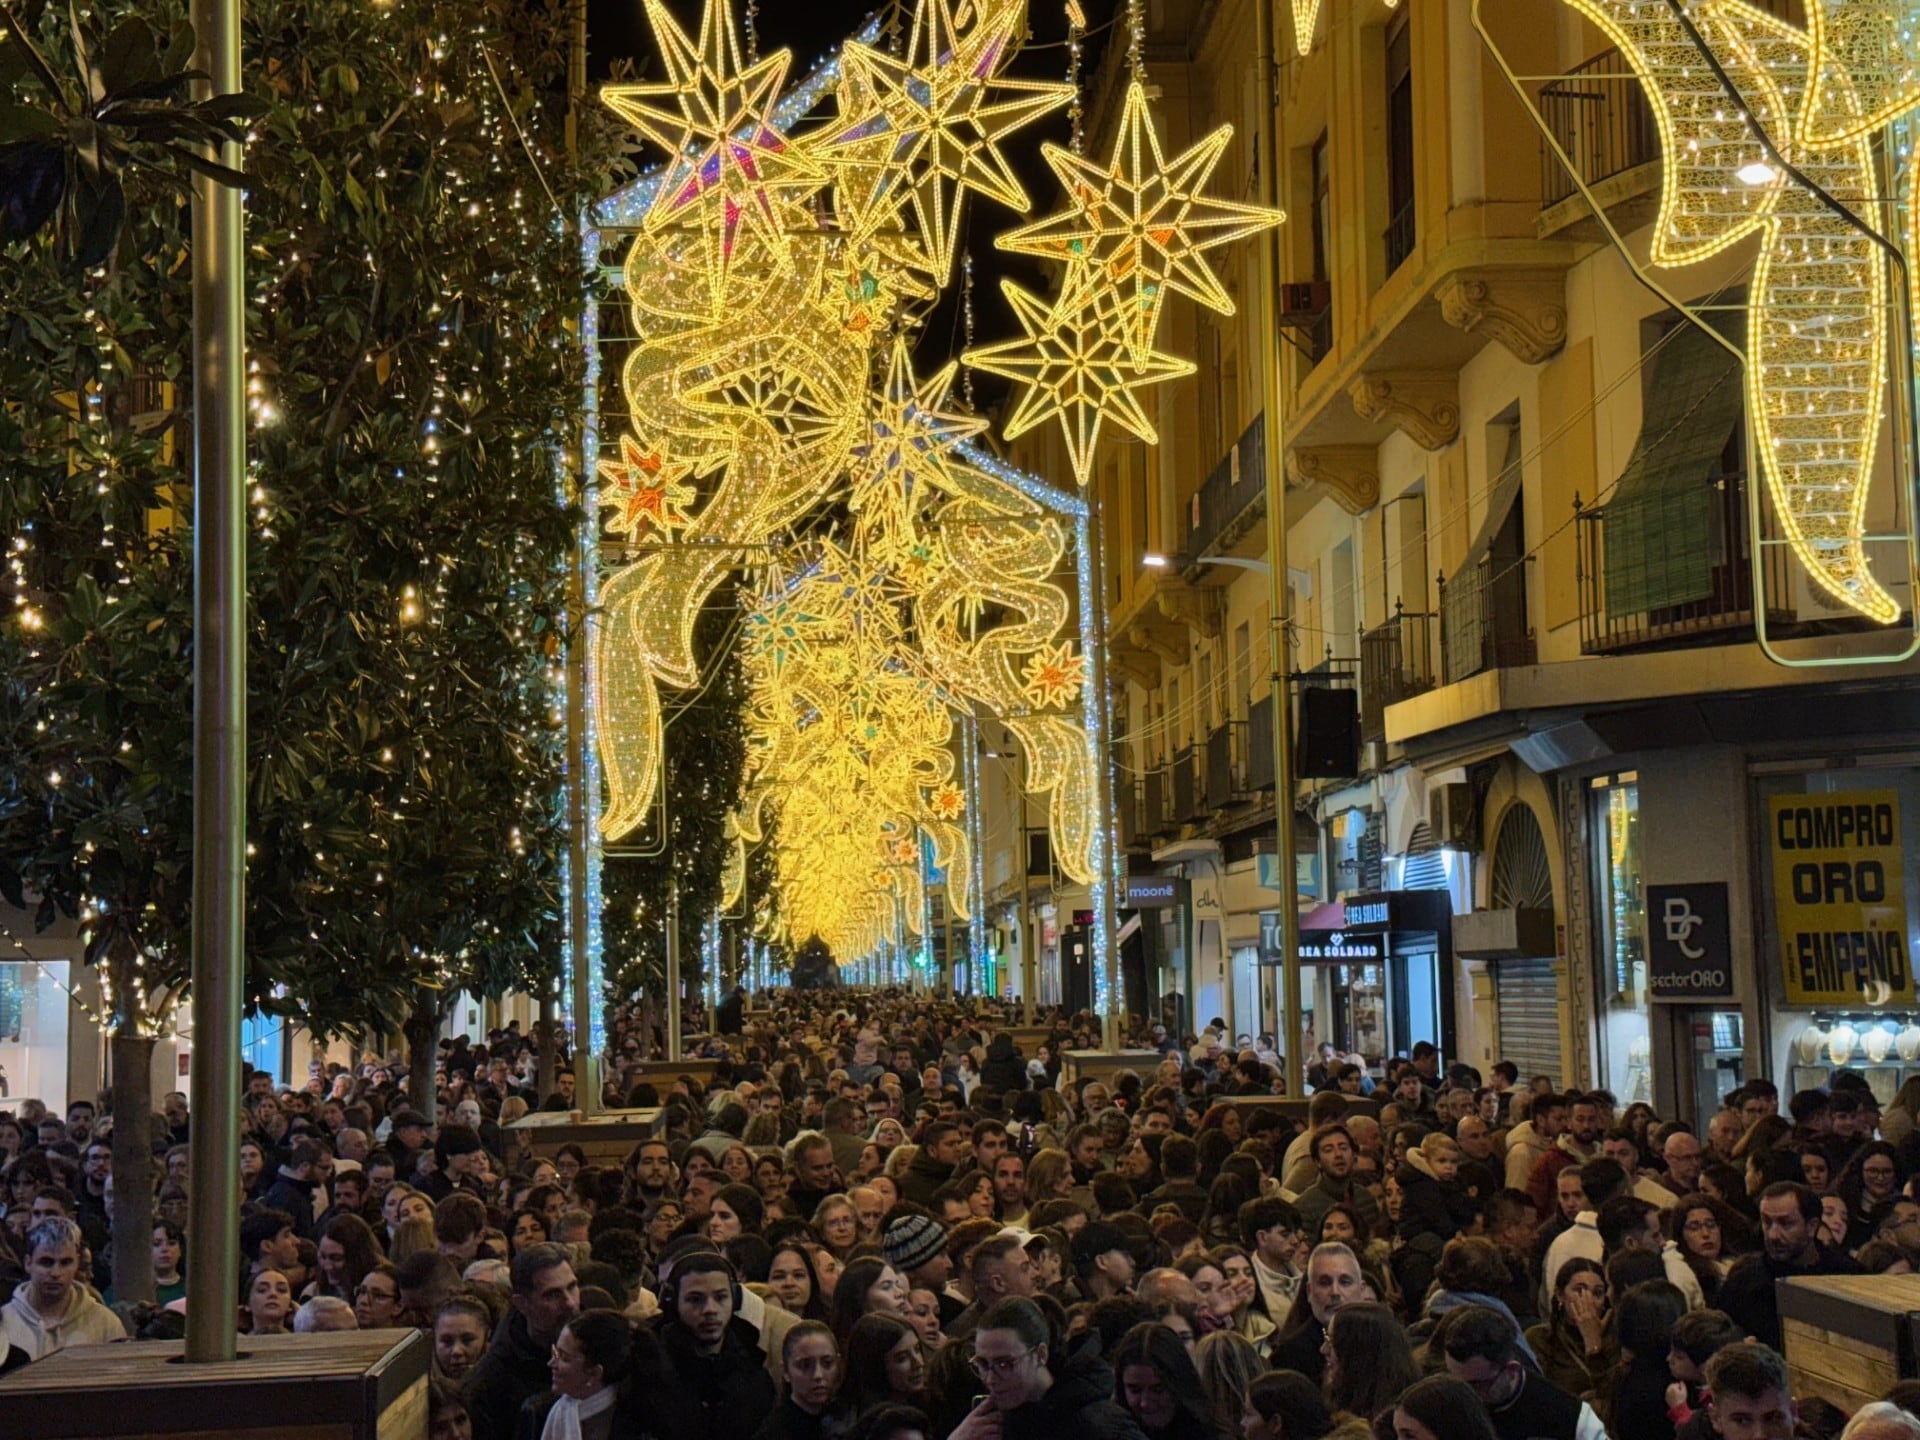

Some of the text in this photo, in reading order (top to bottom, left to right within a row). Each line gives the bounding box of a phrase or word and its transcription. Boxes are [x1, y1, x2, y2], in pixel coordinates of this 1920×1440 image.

[1777, 804, 1893, 849] COMPRO
[1792, 861, 1885, 905] ORO
[1298, 945, 1377, 958] BEA SOLDADO
[1796, 919, 1905, 992] EMPEÑO
